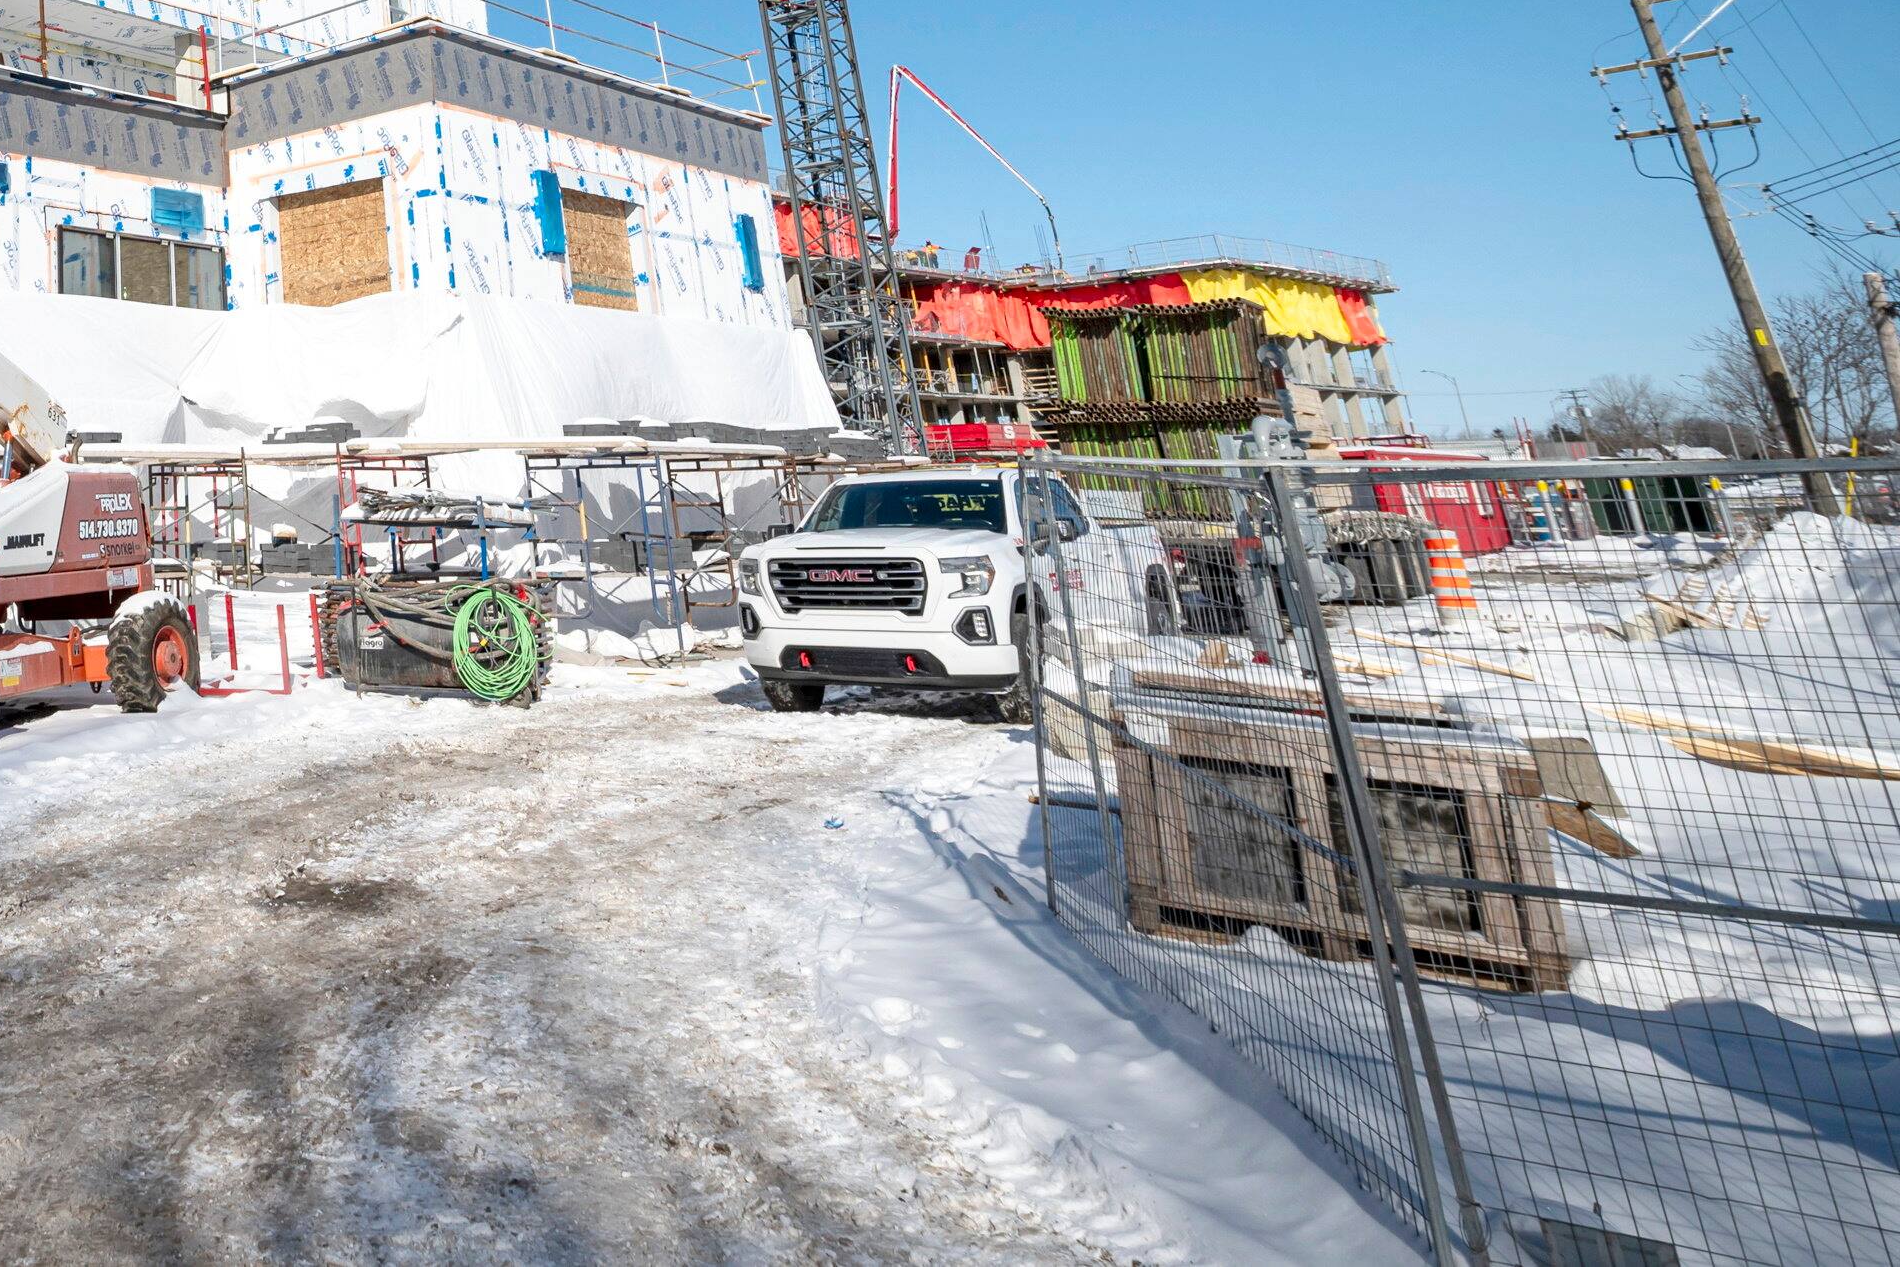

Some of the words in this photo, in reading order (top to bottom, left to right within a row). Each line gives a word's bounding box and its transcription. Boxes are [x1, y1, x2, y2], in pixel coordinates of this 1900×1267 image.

[100, 493, 133, 514] PROLEX
[79, 519, 138, 539] 514.730.9370
[3, 533, 45, 550] MANULIFT
[808, 569, 874, 583] GMC
